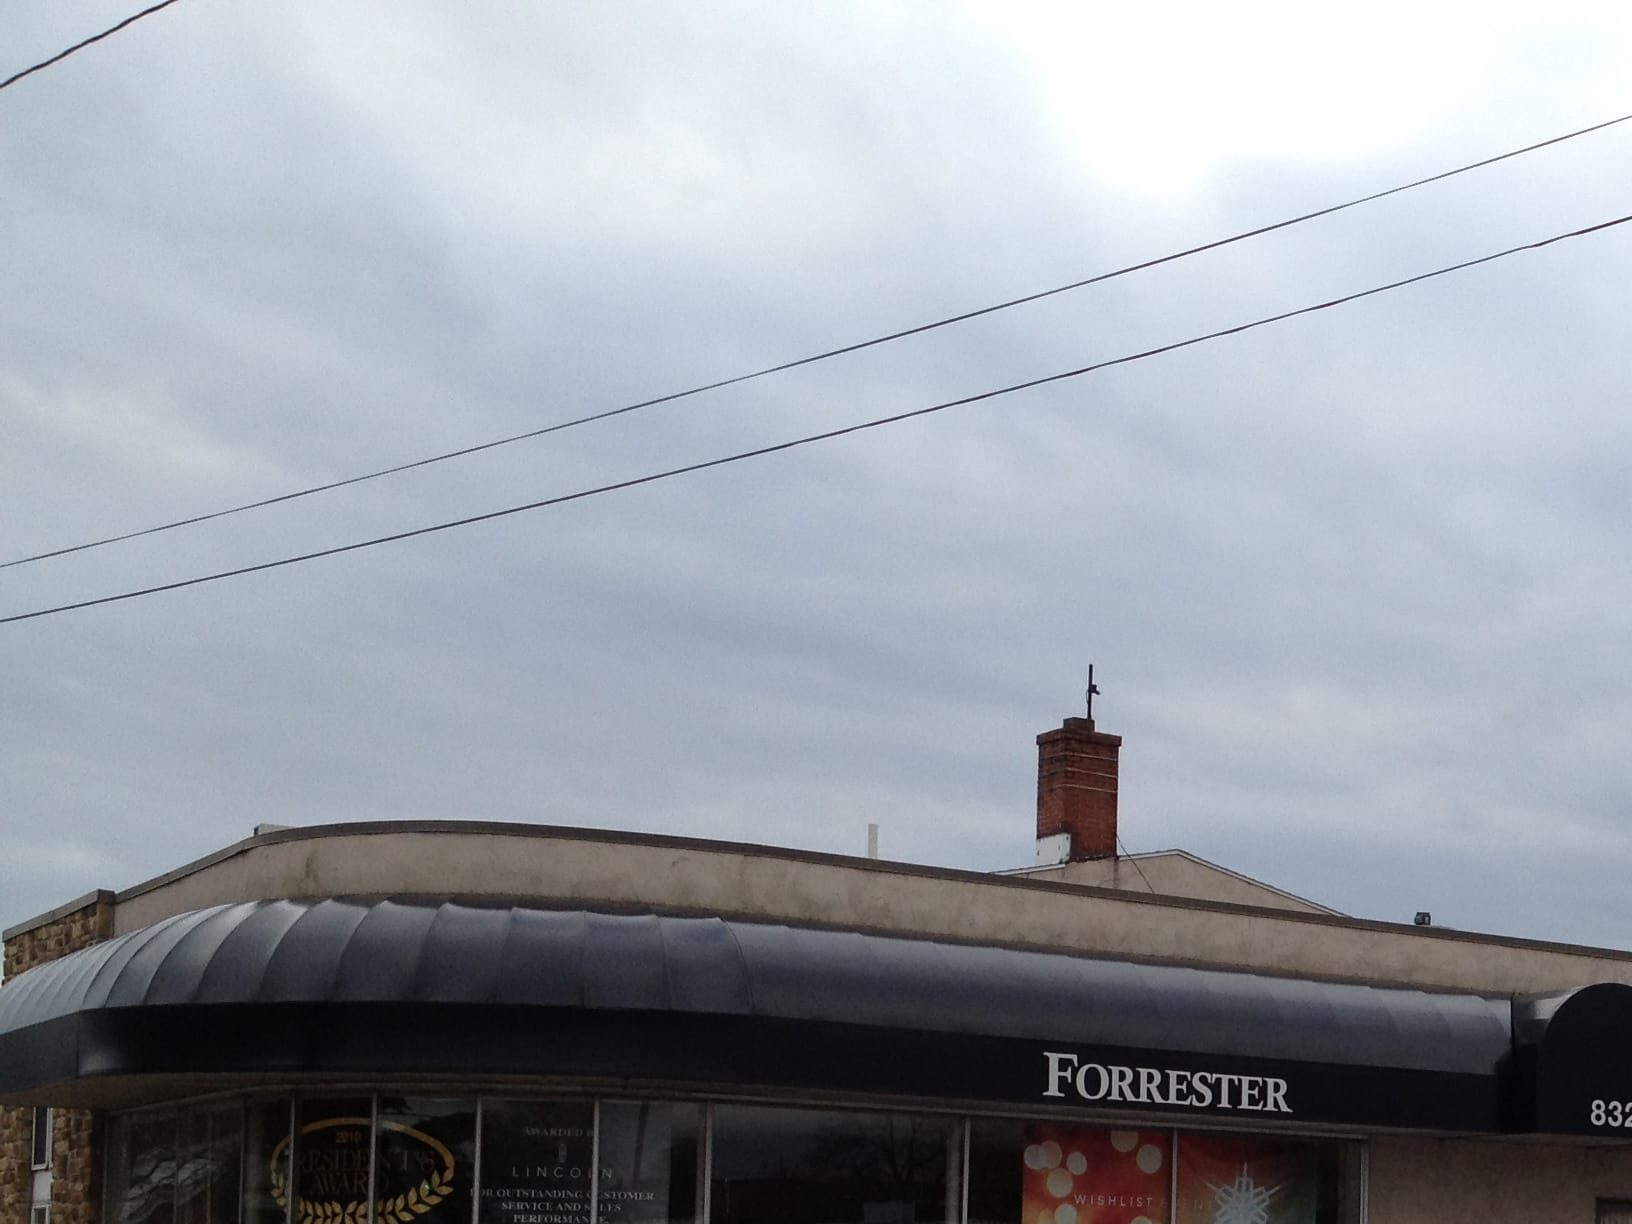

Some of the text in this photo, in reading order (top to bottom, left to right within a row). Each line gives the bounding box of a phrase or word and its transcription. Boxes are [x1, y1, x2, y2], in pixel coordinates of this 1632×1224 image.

[1042, 1051, 1294, 1113] FORRESTER
[496, 1188, 584, 1200] OUTSTANDING
[586, 1190, 655, 1201] CSTOMER
[1074, 1194, 1153, 1208] WISHLIST
[501, 1201, 623, 1213] SERVICE AND SLES
[513, 1213, 610, 1224] PERFORMANE.
